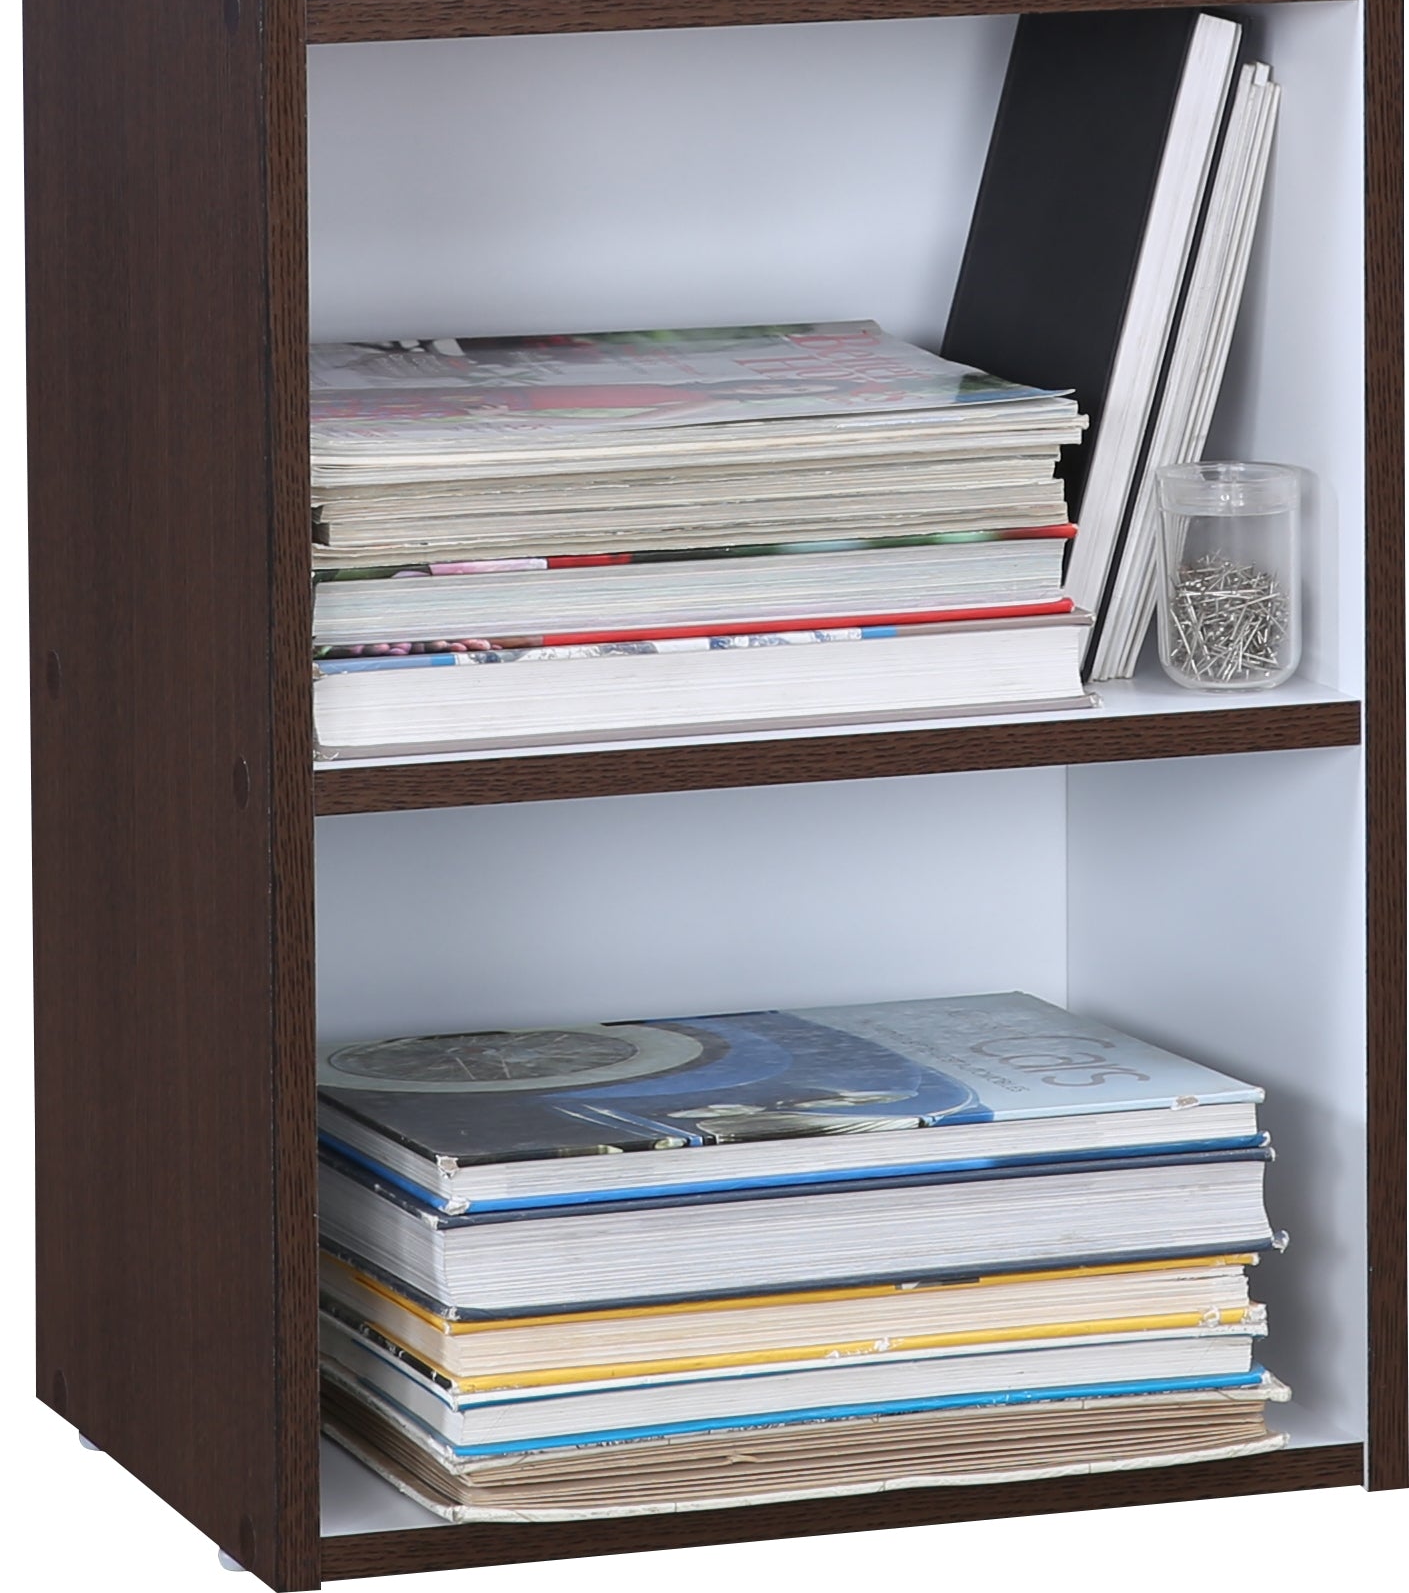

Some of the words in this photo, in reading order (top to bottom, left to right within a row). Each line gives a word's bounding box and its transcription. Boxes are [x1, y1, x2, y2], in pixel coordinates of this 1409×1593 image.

[733, 357, 908, 402] Hoes
[785, 333, 932, 380] Better
[969, 1035, 1150, 1088] Cars
